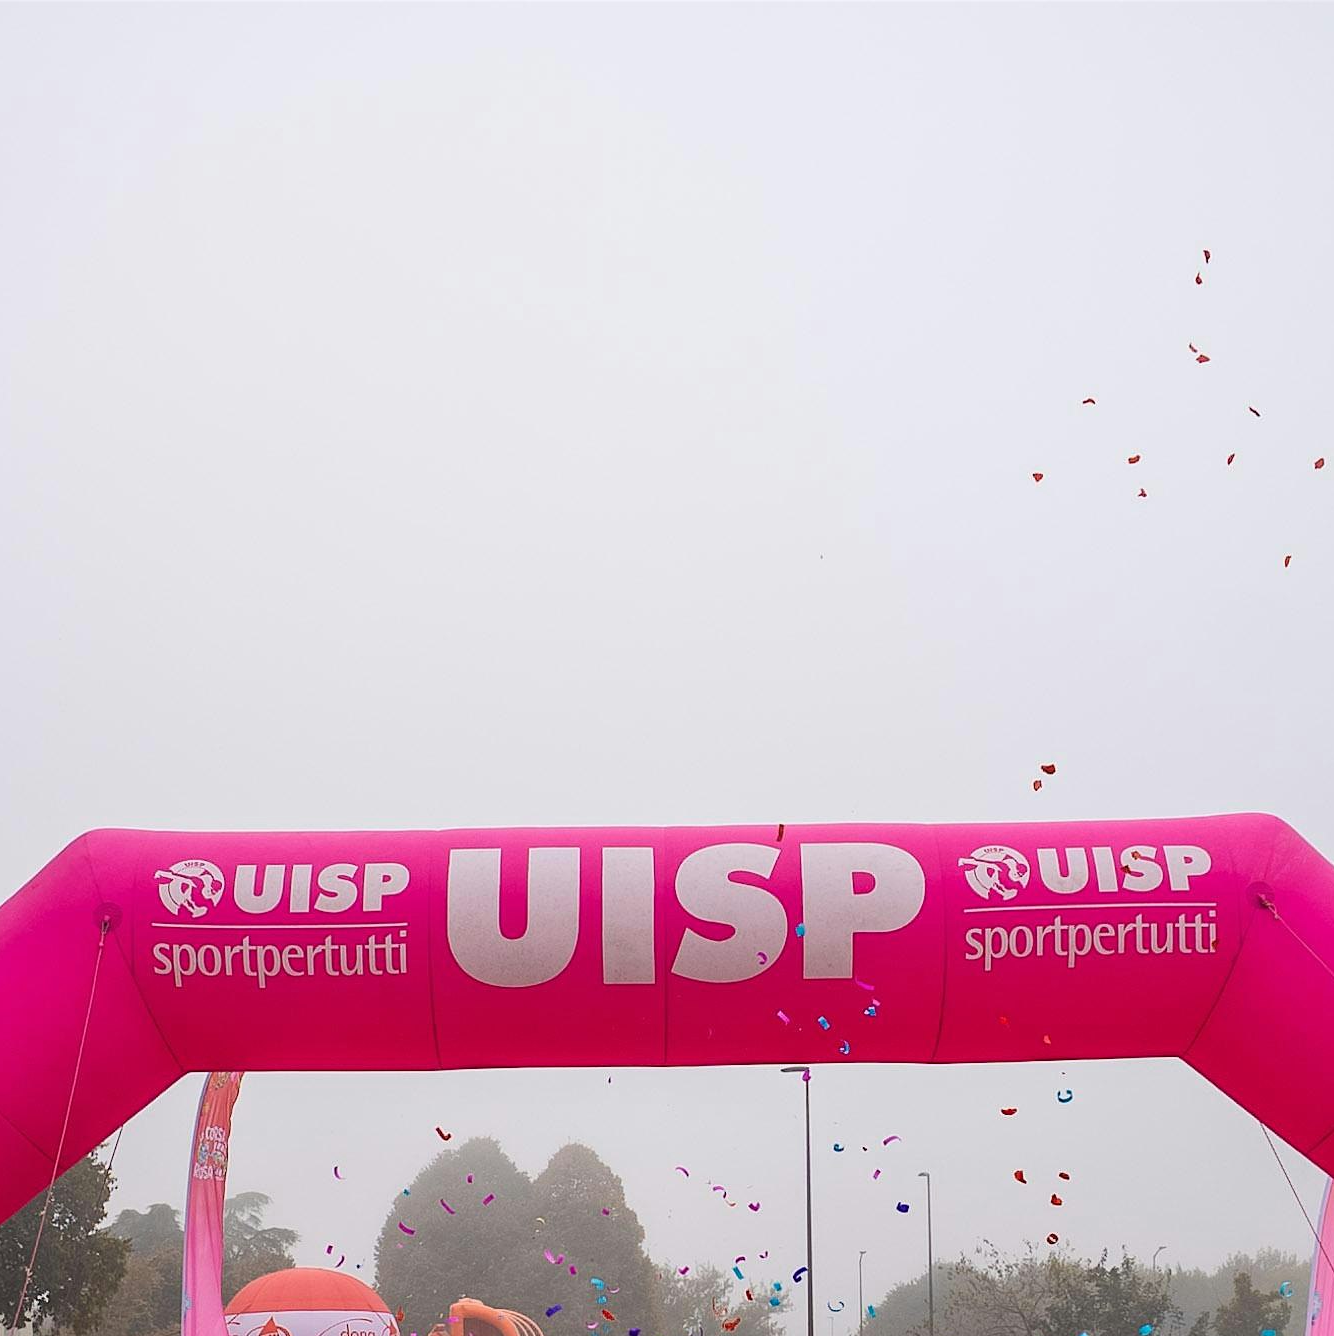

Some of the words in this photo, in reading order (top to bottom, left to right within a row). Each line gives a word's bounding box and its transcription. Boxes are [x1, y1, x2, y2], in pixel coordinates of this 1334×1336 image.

[234, 863, 410, 914] UISP
[1037, 845, 1212, 892] UISP
[447, 843, 926, 987] UISP
[965, 910, 1217, 971] sportpertutti
[153, 930, 408, 988] sportpertutti
